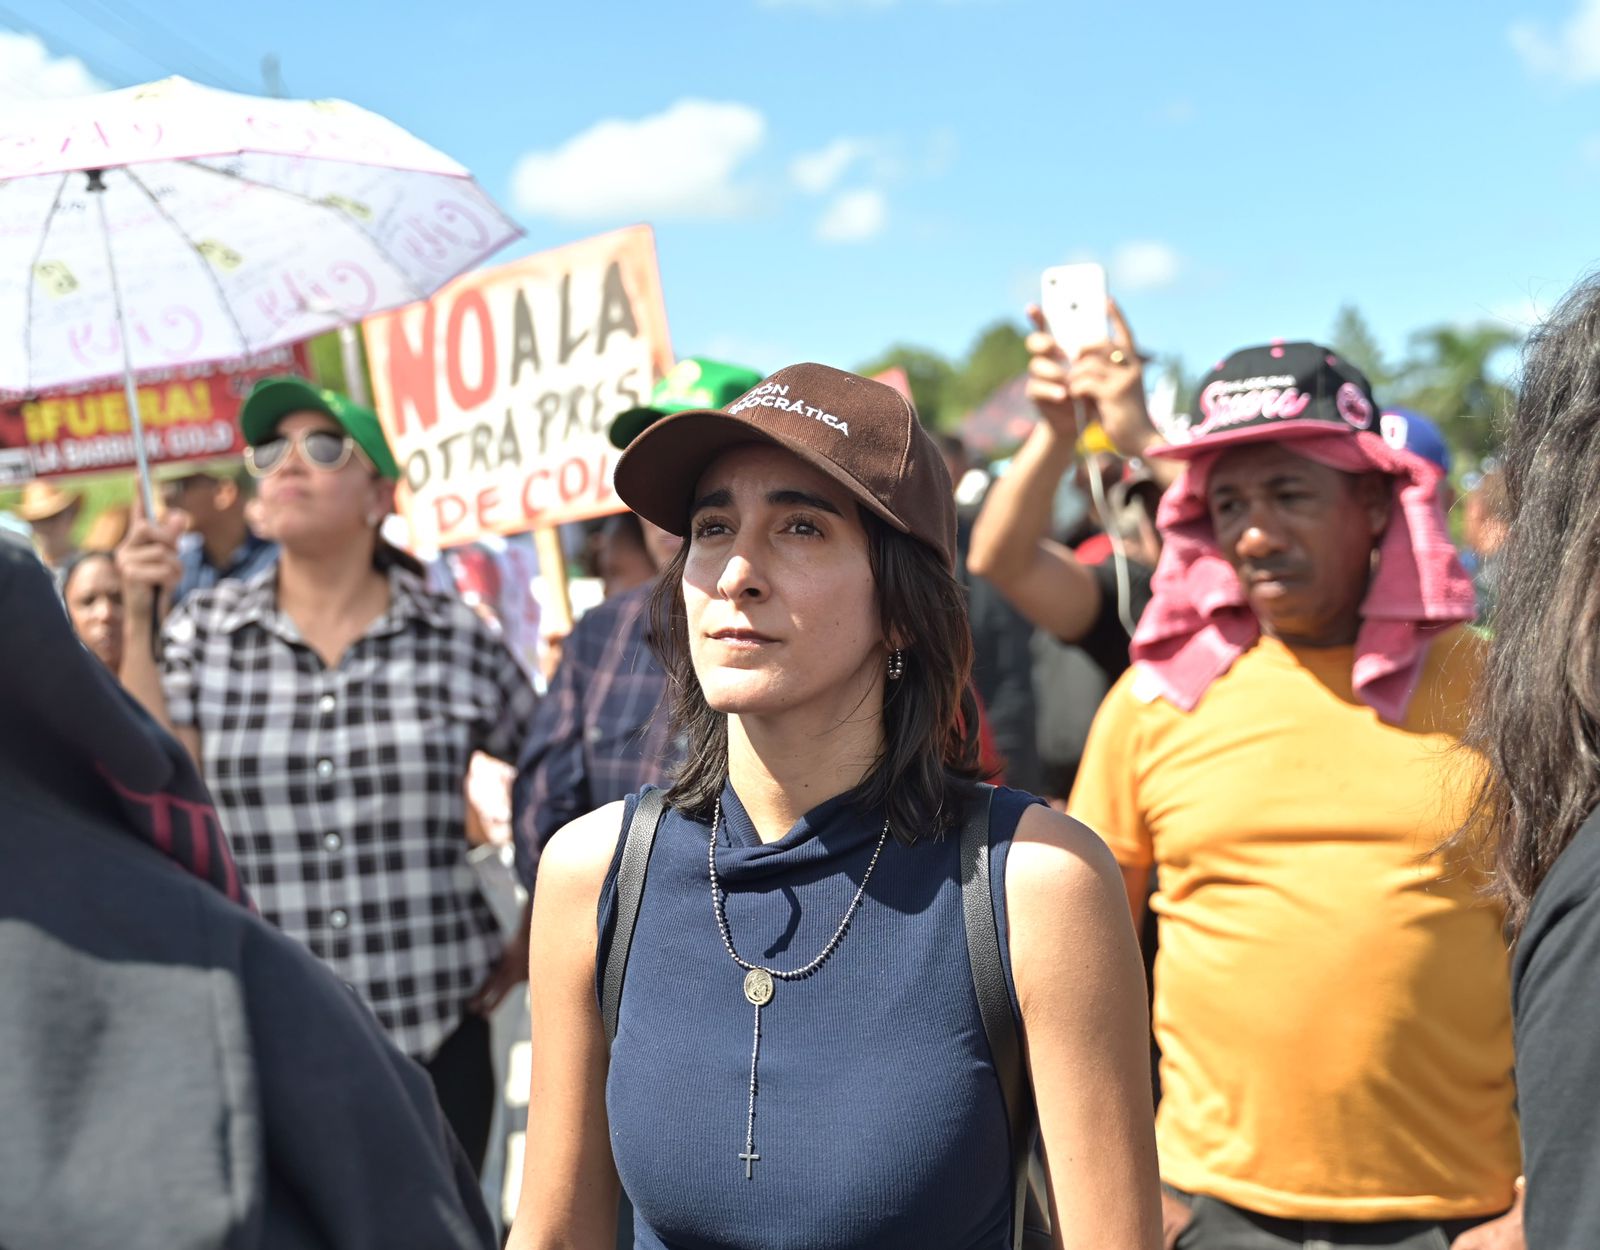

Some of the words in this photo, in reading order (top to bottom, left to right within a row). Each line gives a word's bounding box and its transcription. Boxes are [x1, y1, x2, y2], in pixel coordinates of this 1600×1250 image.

[386, 287, 497, 437] NO
[510, 287, 542, 387] A
[557, 260, 639, 366] LA
[61, 428, 166, 468] BARRIK
[404, 407, 522, 494] OTRA
[433, 486, 501, 533] DE
[520, 455, 616, 521] COL
